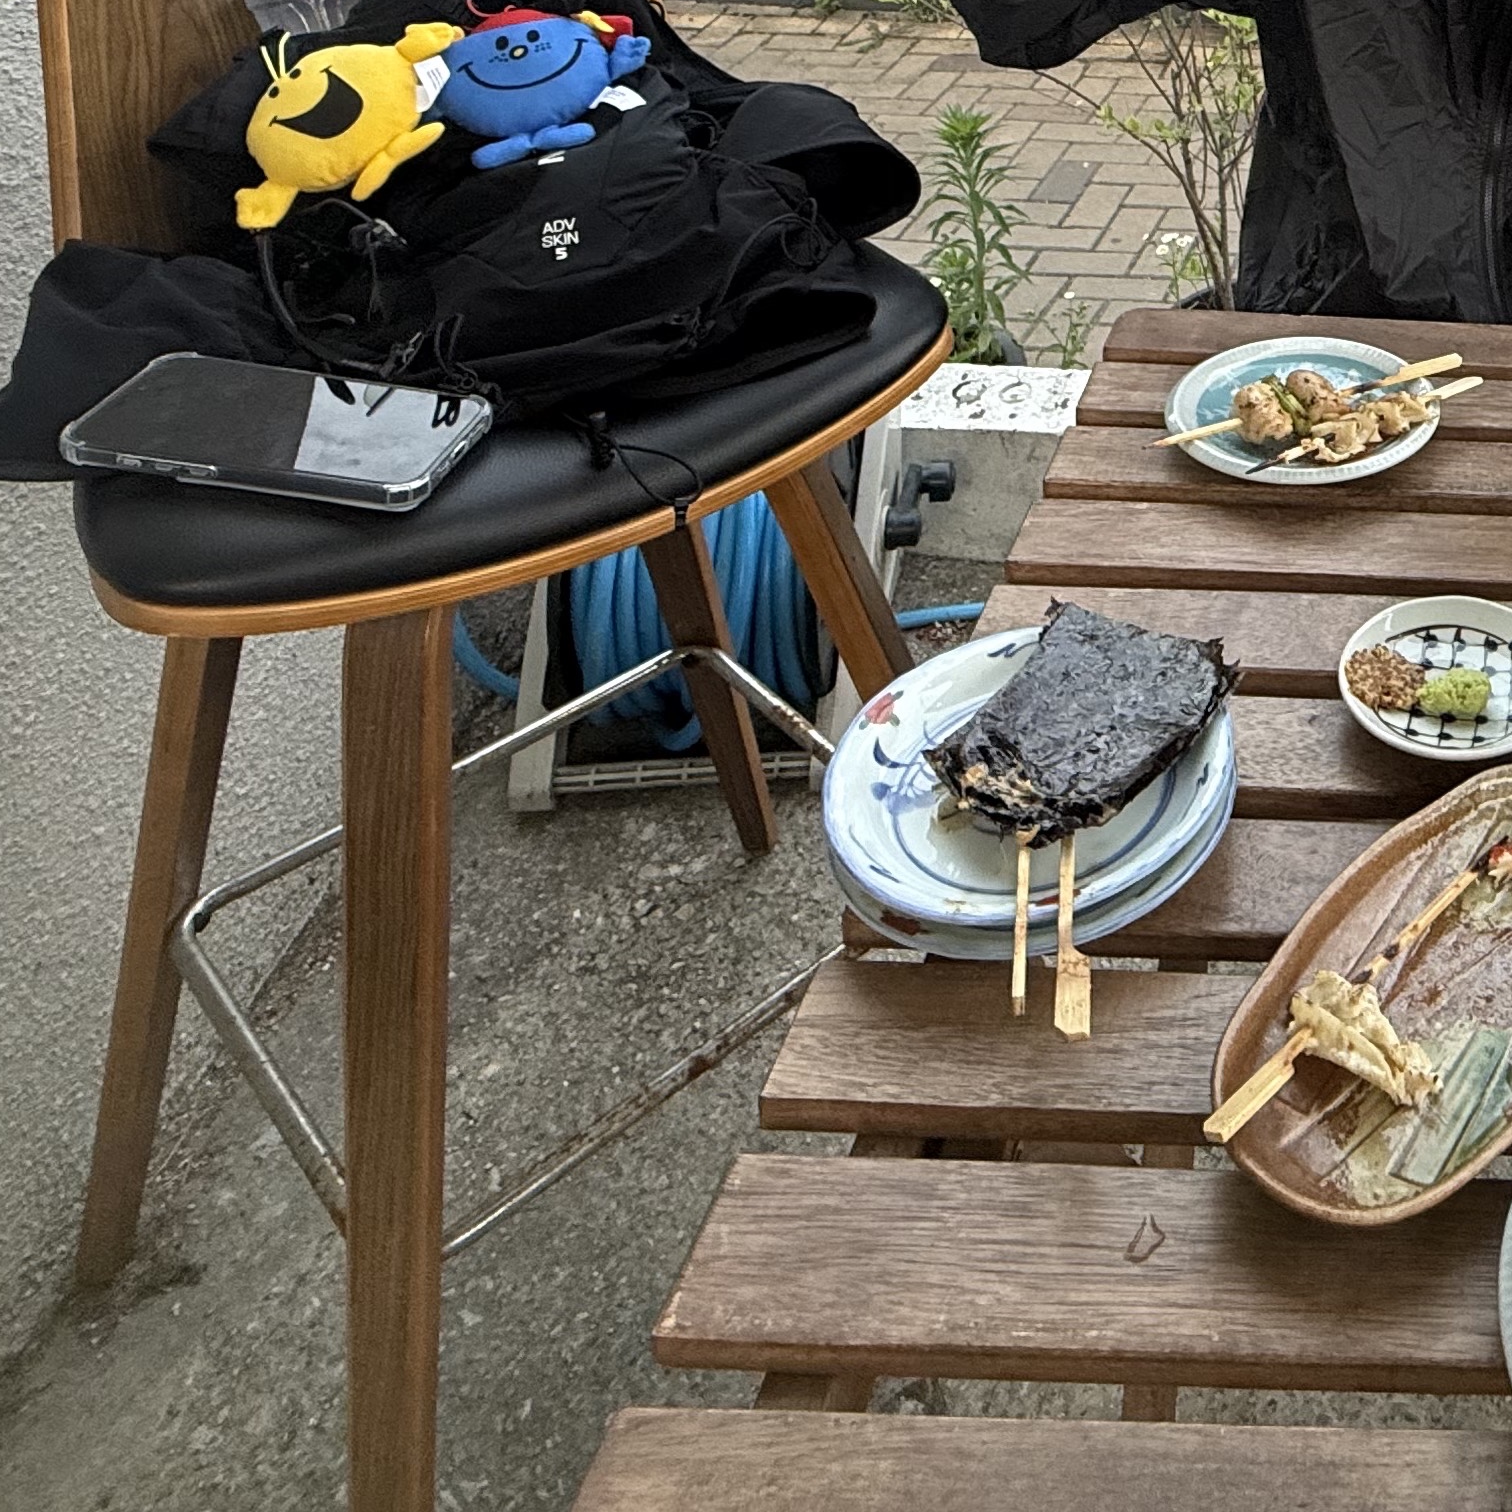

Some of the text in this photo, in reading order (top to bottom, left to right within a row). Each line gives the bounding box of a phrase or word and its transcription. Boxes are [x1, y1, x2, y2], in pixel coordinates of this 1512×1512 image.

[542, 217, 576, 234] ADV
[541, 231, 580, 248] SKIN
[555, 247, 568, 260] 5
